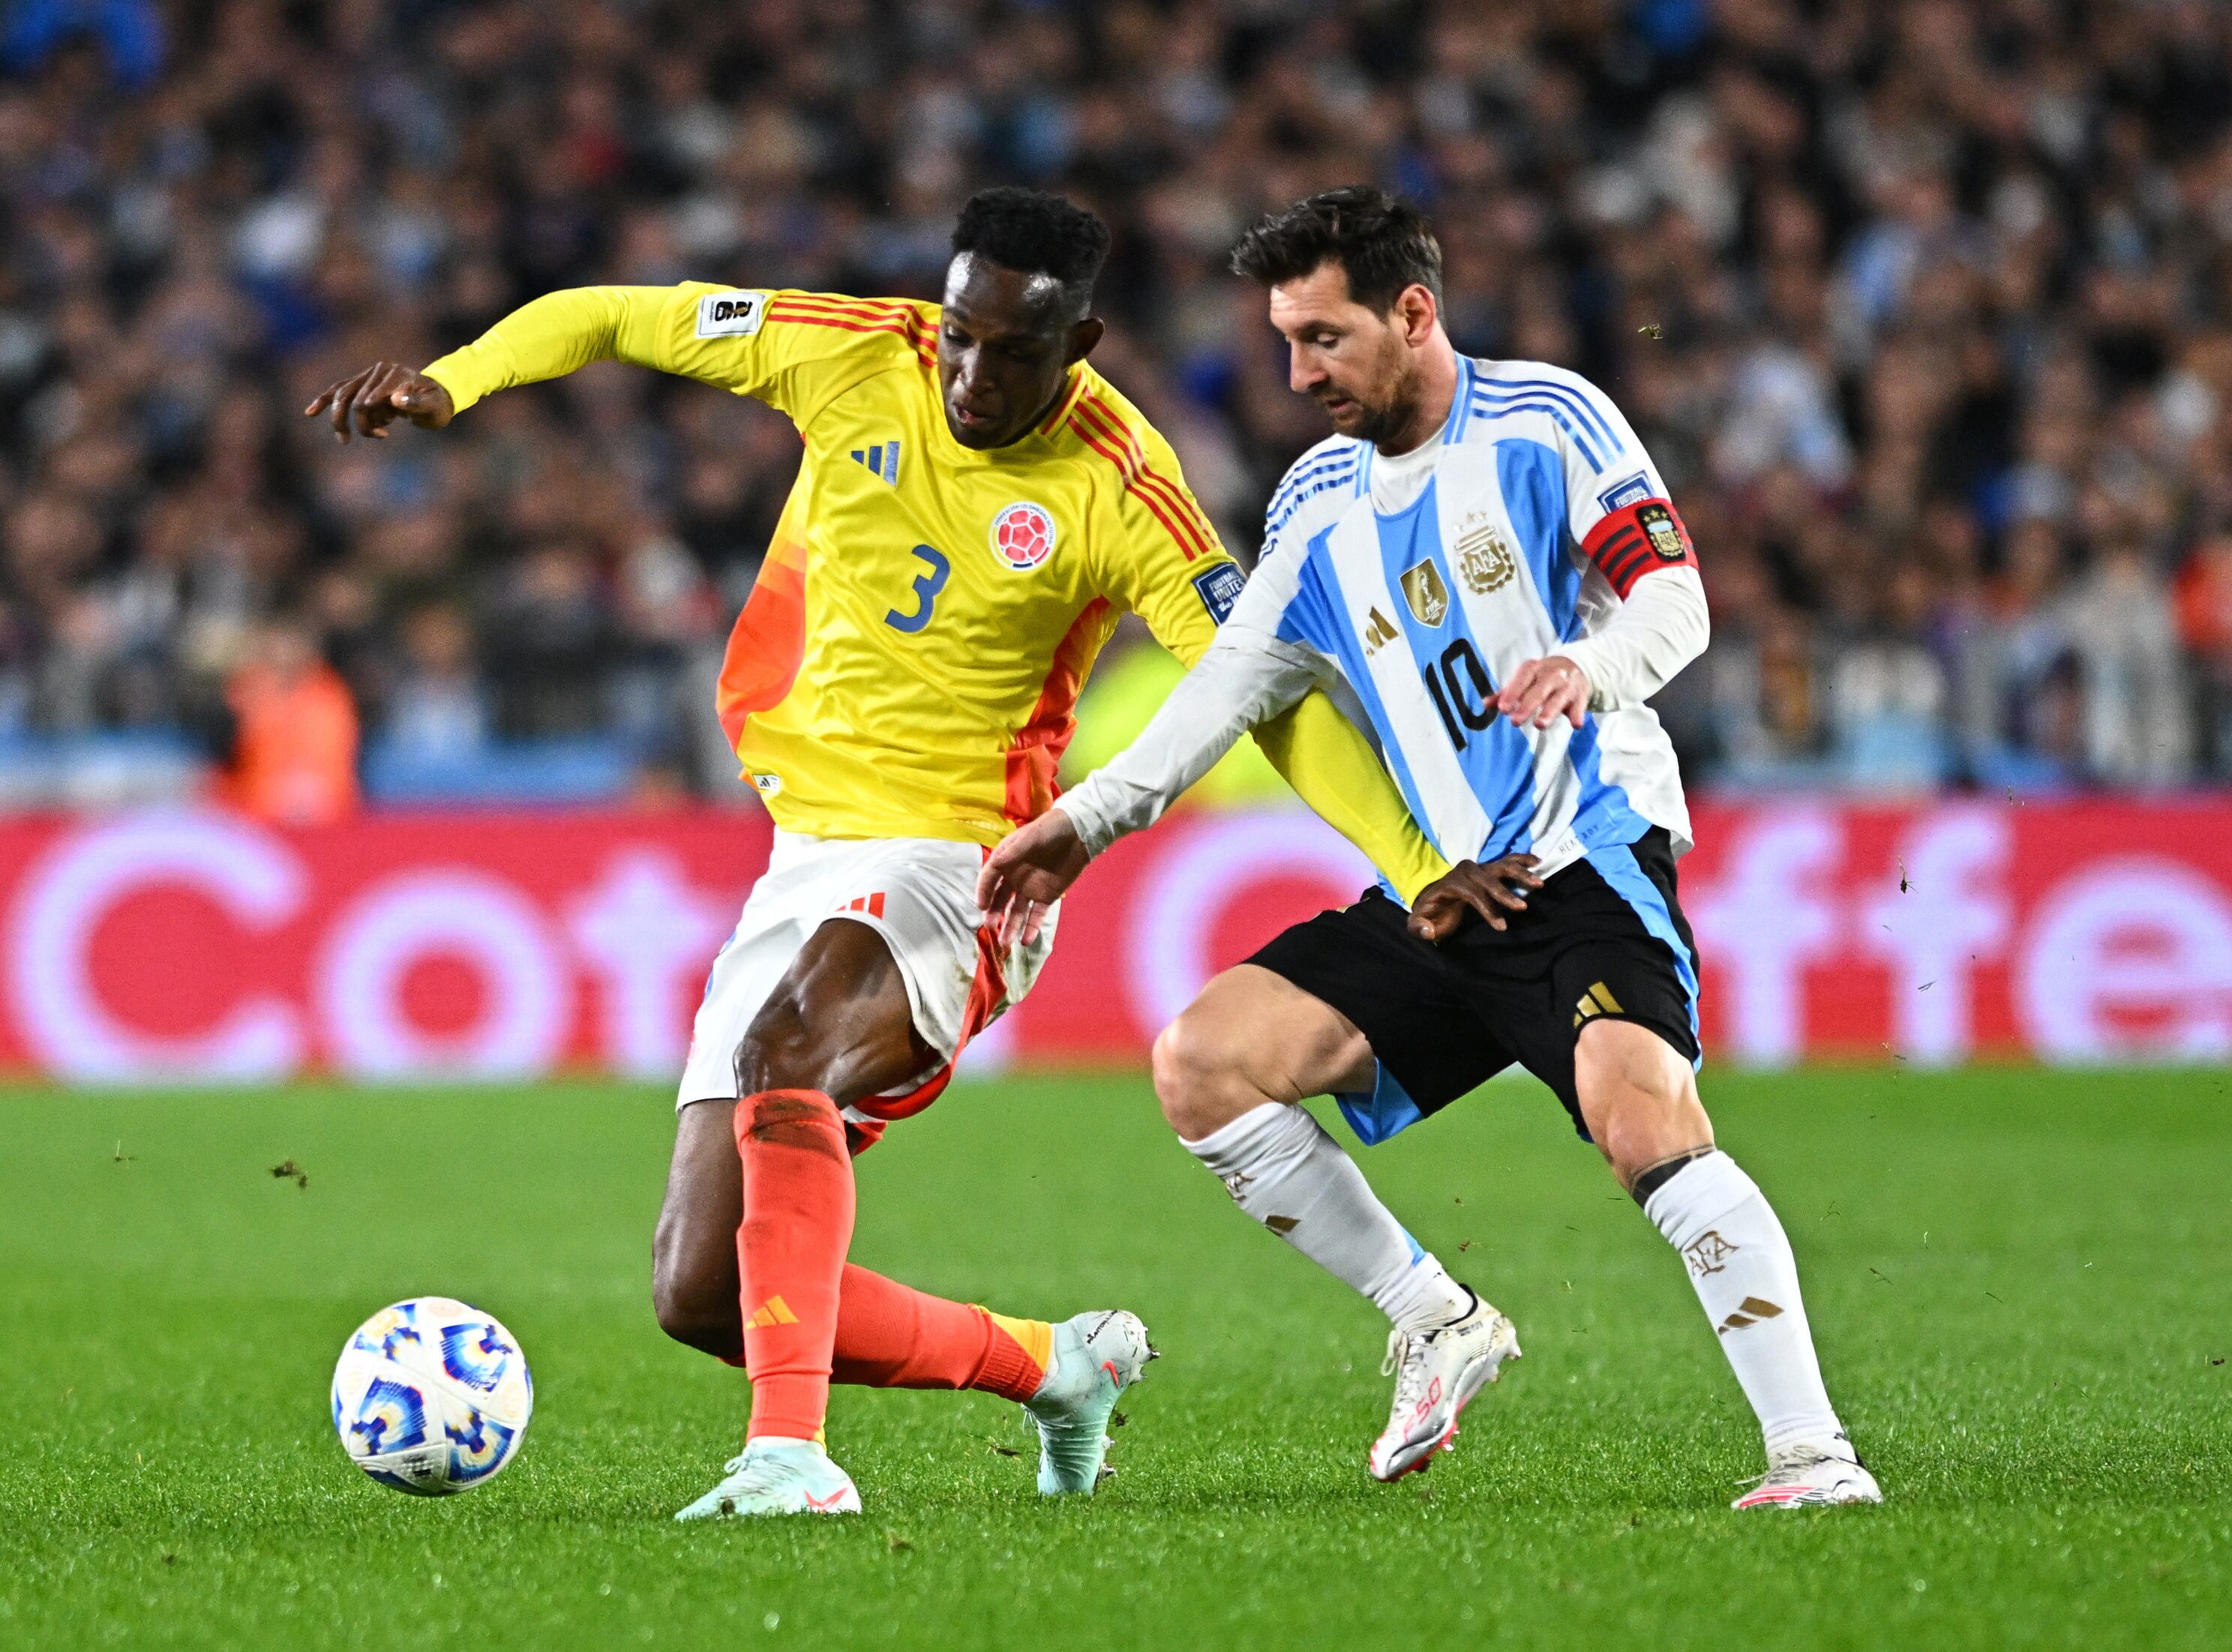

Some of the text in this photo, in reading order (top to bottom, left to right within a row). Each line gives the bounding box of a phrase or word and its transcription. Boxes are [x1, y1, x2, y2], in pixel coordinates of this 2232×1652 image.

[884, 544, 950, 633] 3
[1471, 544, 1502, 576] AFA
[1425, 638, 1499, 752] 10
[1685, 1230, 1740, 1277] AFA
